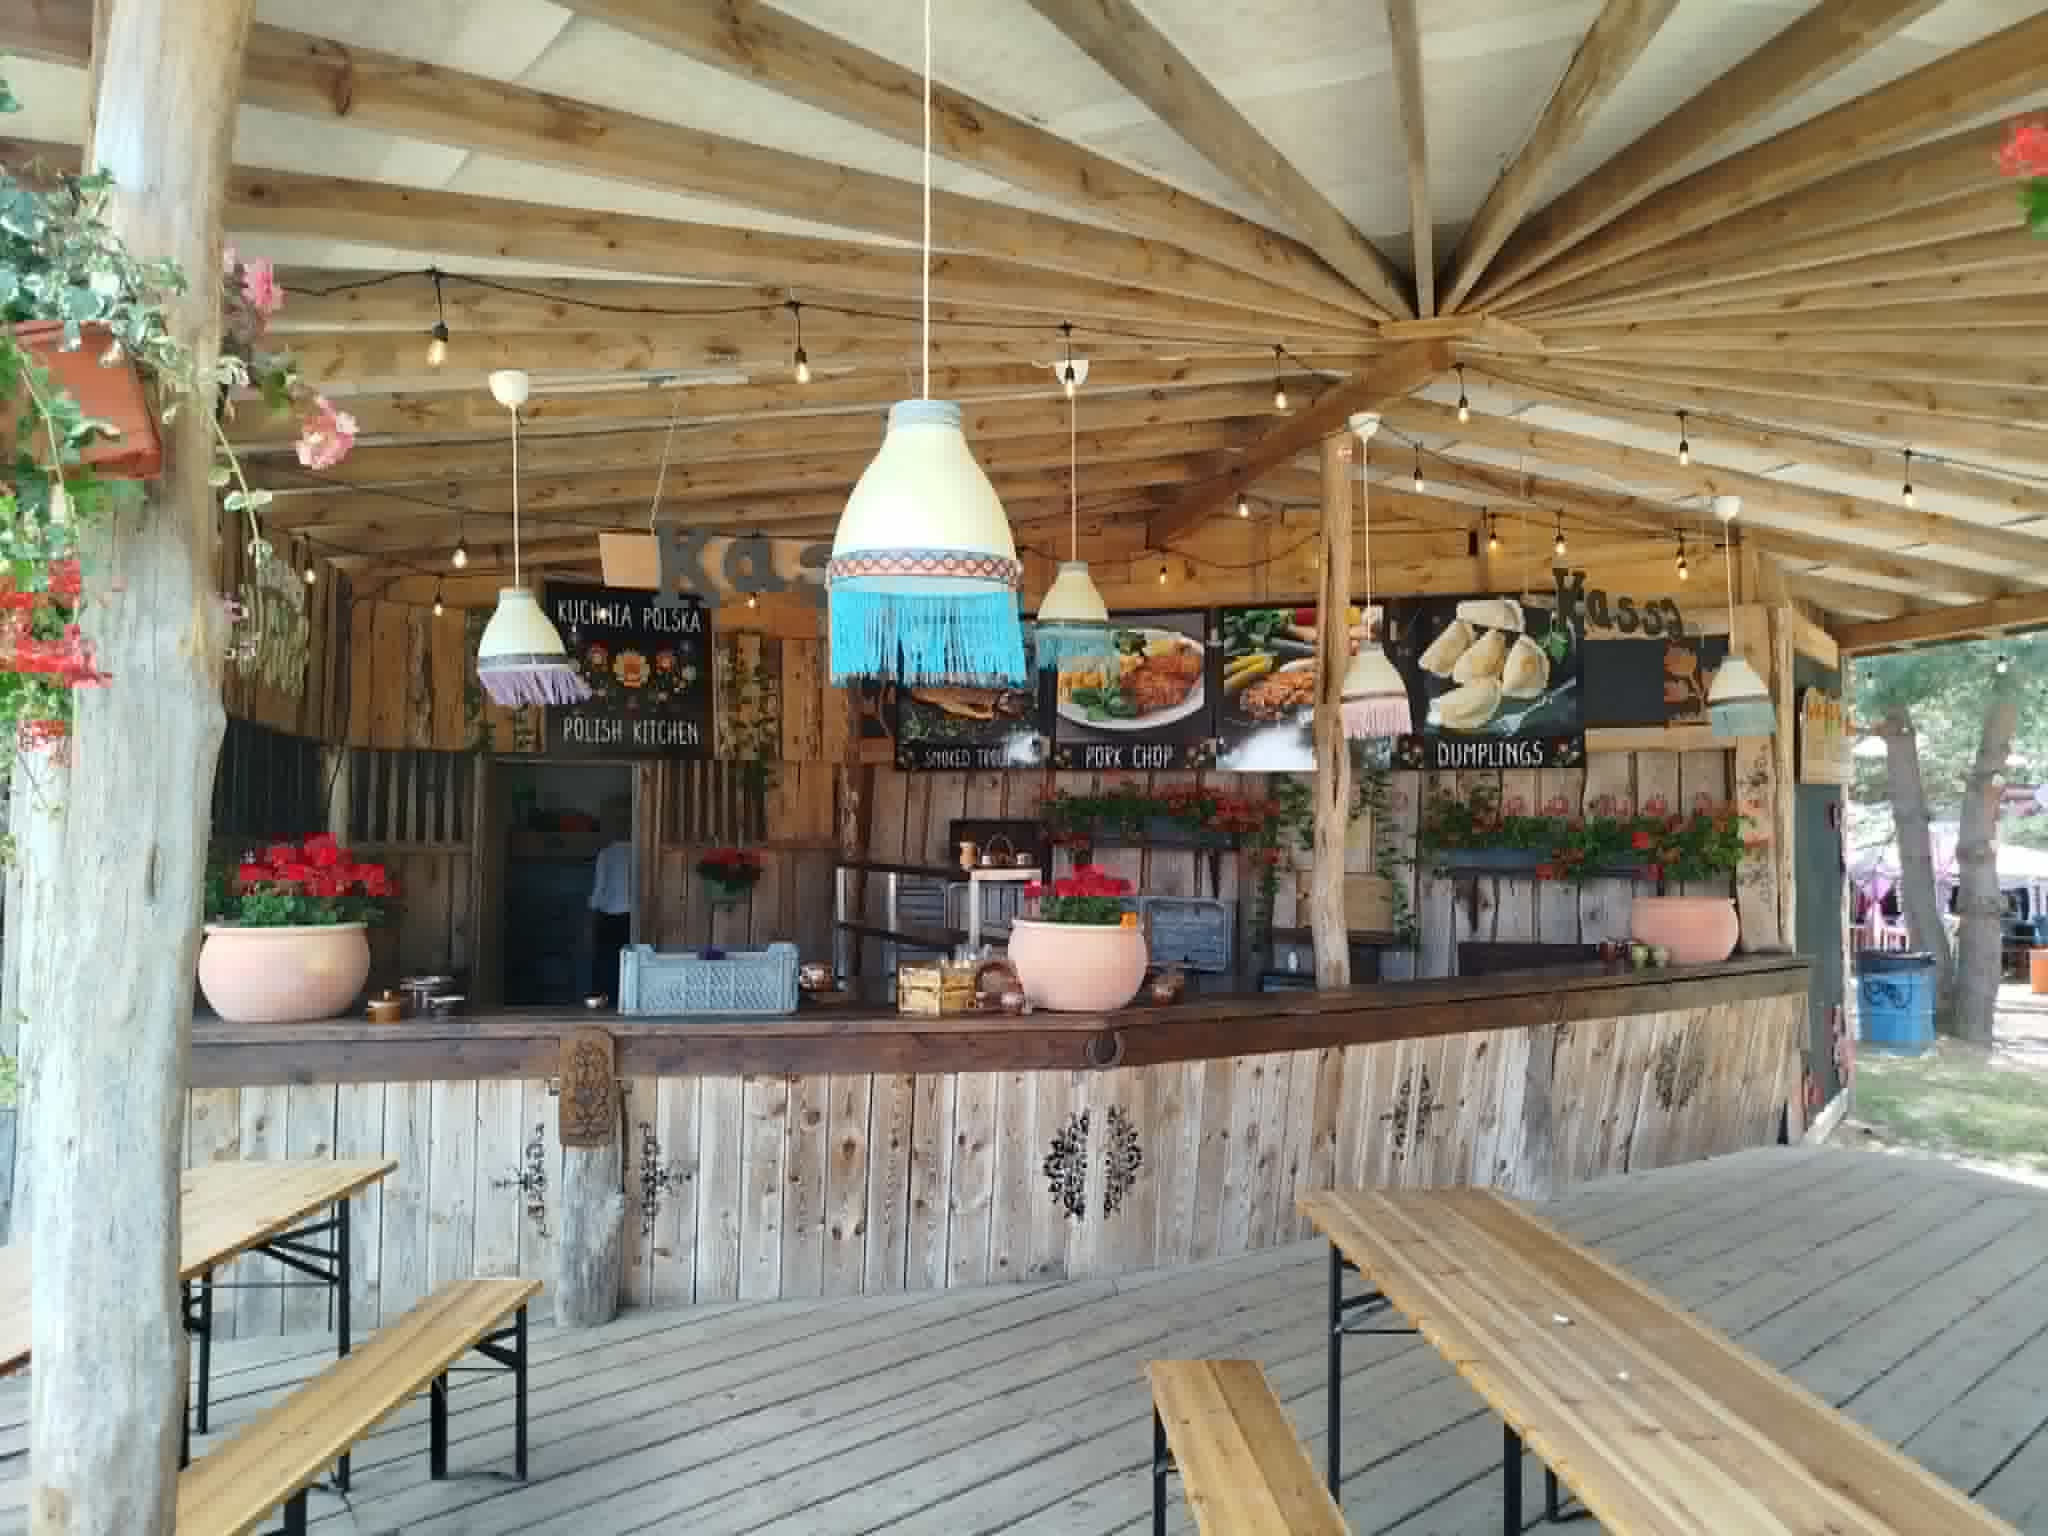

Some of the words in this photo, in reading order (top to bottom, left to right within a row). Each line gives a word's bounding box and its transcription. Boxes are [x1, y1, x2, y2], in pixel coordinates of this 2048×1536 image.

[643, 607, 702, 633] POLSKA
[562, 718, 622, 744] POLISH
[633, 719, 699, 745] KITCHEN
[1086, 744, 1121, 769] PORK
[1133, 743, 1174, 769] CHOP
[1437, 740, 1544, 769] DUMPLINGS
